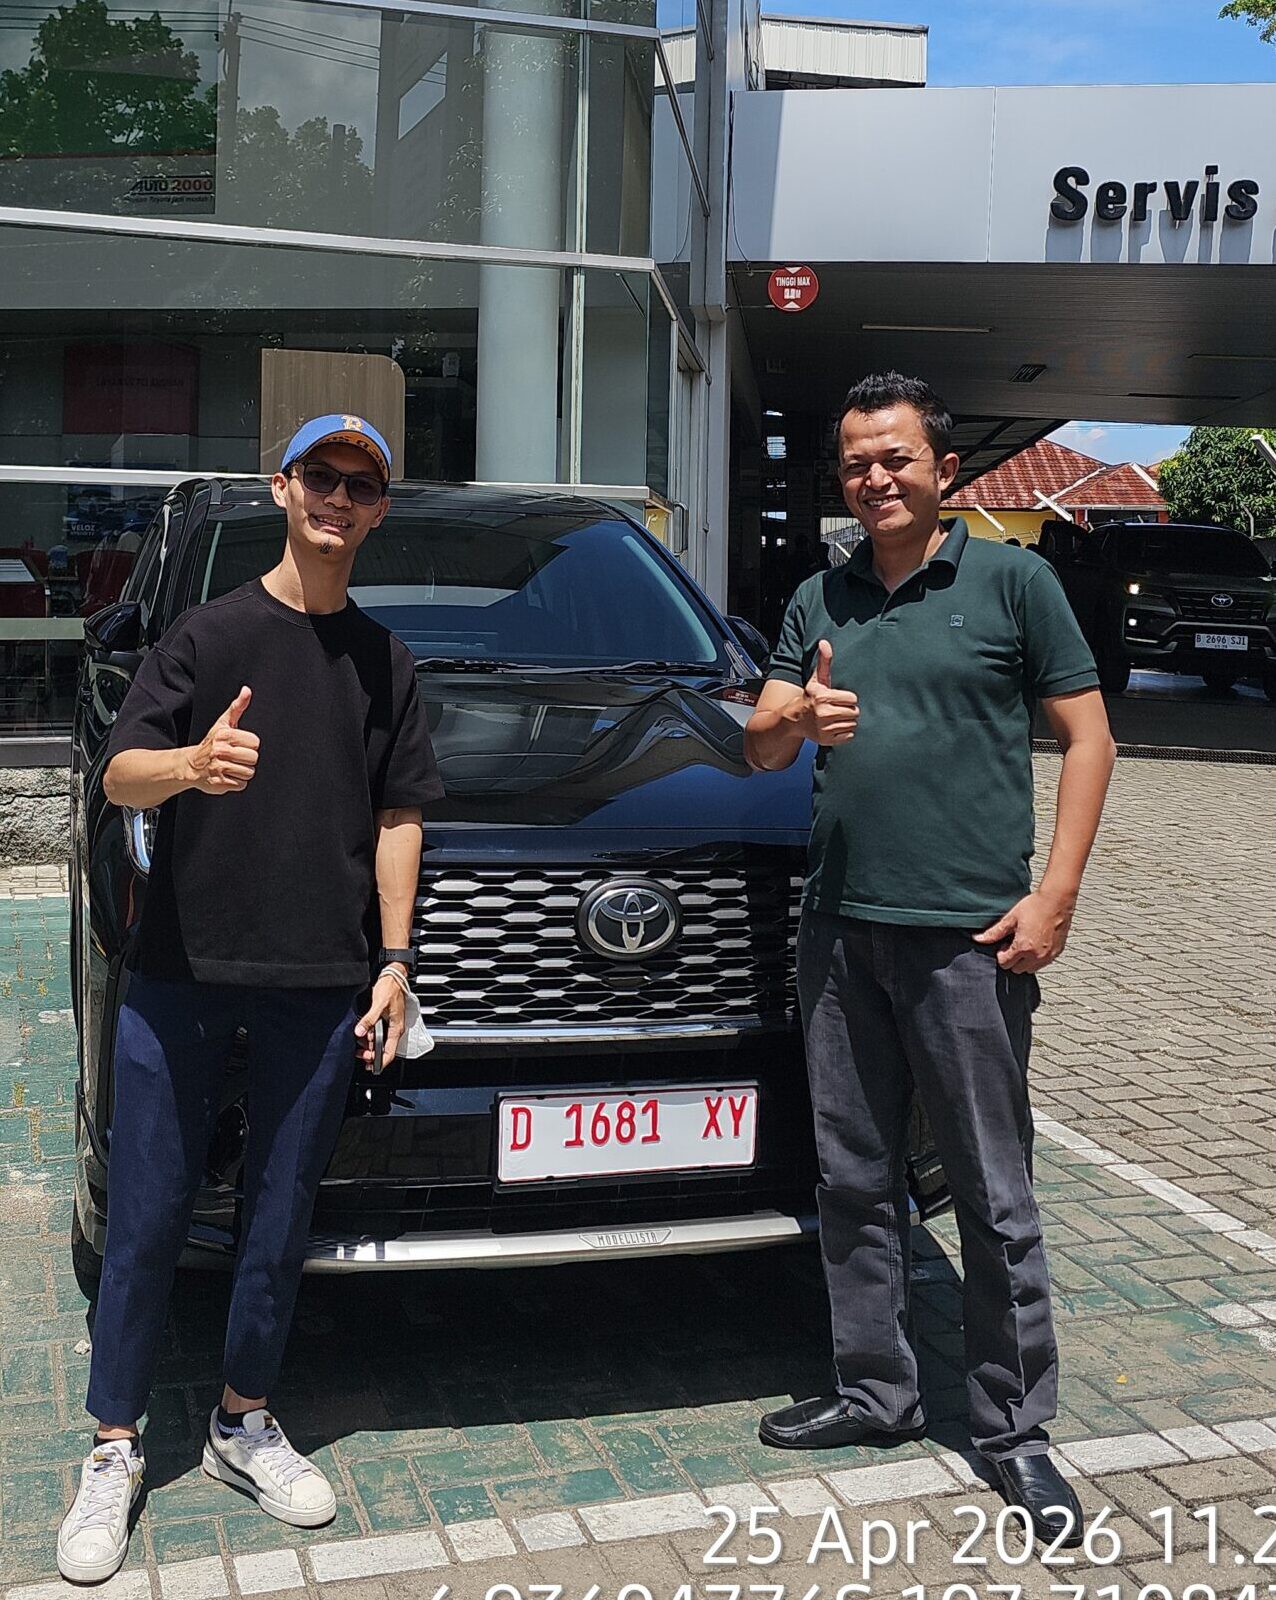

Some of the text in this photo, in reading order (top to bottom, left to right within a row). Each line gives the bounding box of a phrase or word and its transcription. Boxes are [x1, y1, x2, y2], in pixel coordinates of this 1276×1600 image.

[171, 179, 213, 191] 2000
[1050, 165, 1259, 222] Servis
[775, 276, 811, 286] TINGGI MAX
[1196, 635, 1201, 643] B
[1206, 635, 1227, 643] 2696
[510, 1095, 748, 1151] D 1681 XY
[597, 1231, 657, 1246] MODELLISTA
